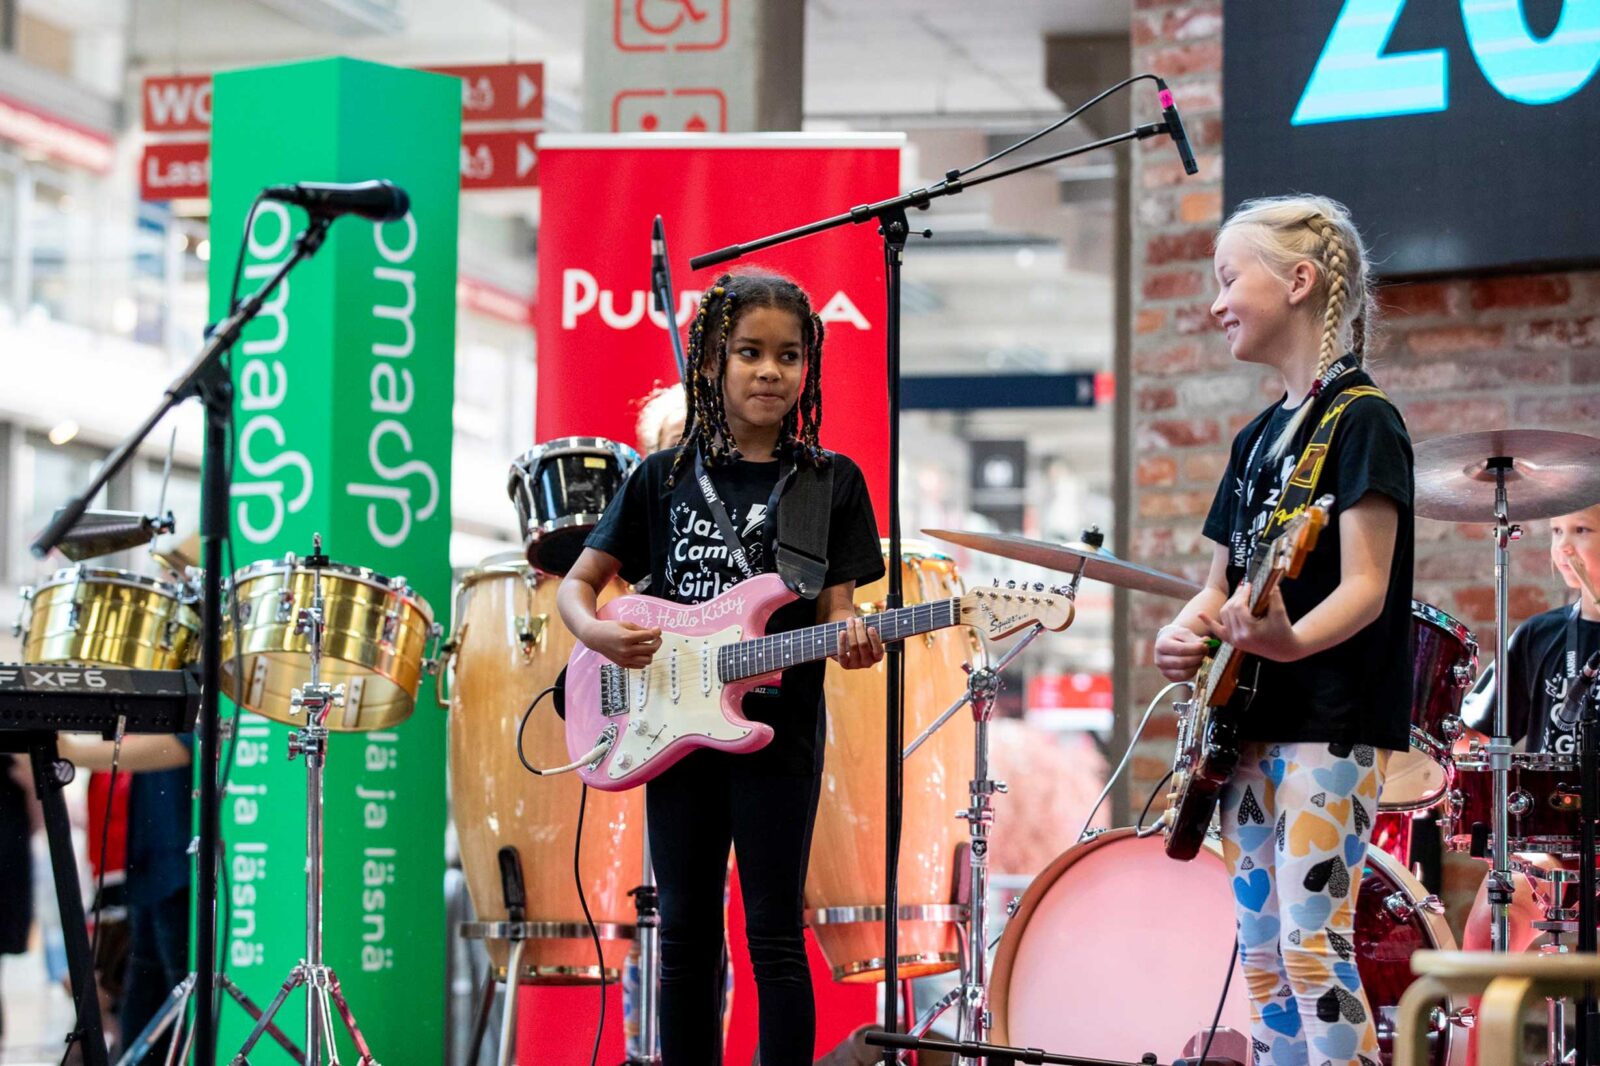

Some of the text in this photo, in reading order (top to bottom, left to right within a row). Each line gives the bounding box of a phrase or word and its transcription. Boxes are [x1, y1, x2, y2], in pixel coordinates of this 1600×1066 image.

[147, 155, 211, 188] Las
[700, 474, 718, 504] KARHU
[731, 548, 755, 579] KARHU
[656, 595, 746, 628] Hello Kitty
[29, 670, 107, 688] XF6
[226, 779, 268, 825] ja
[356, 785, 396, 829] ja
[231, 842, 268, 967] läsnä
[361, 848, 397, 973] läsnä
